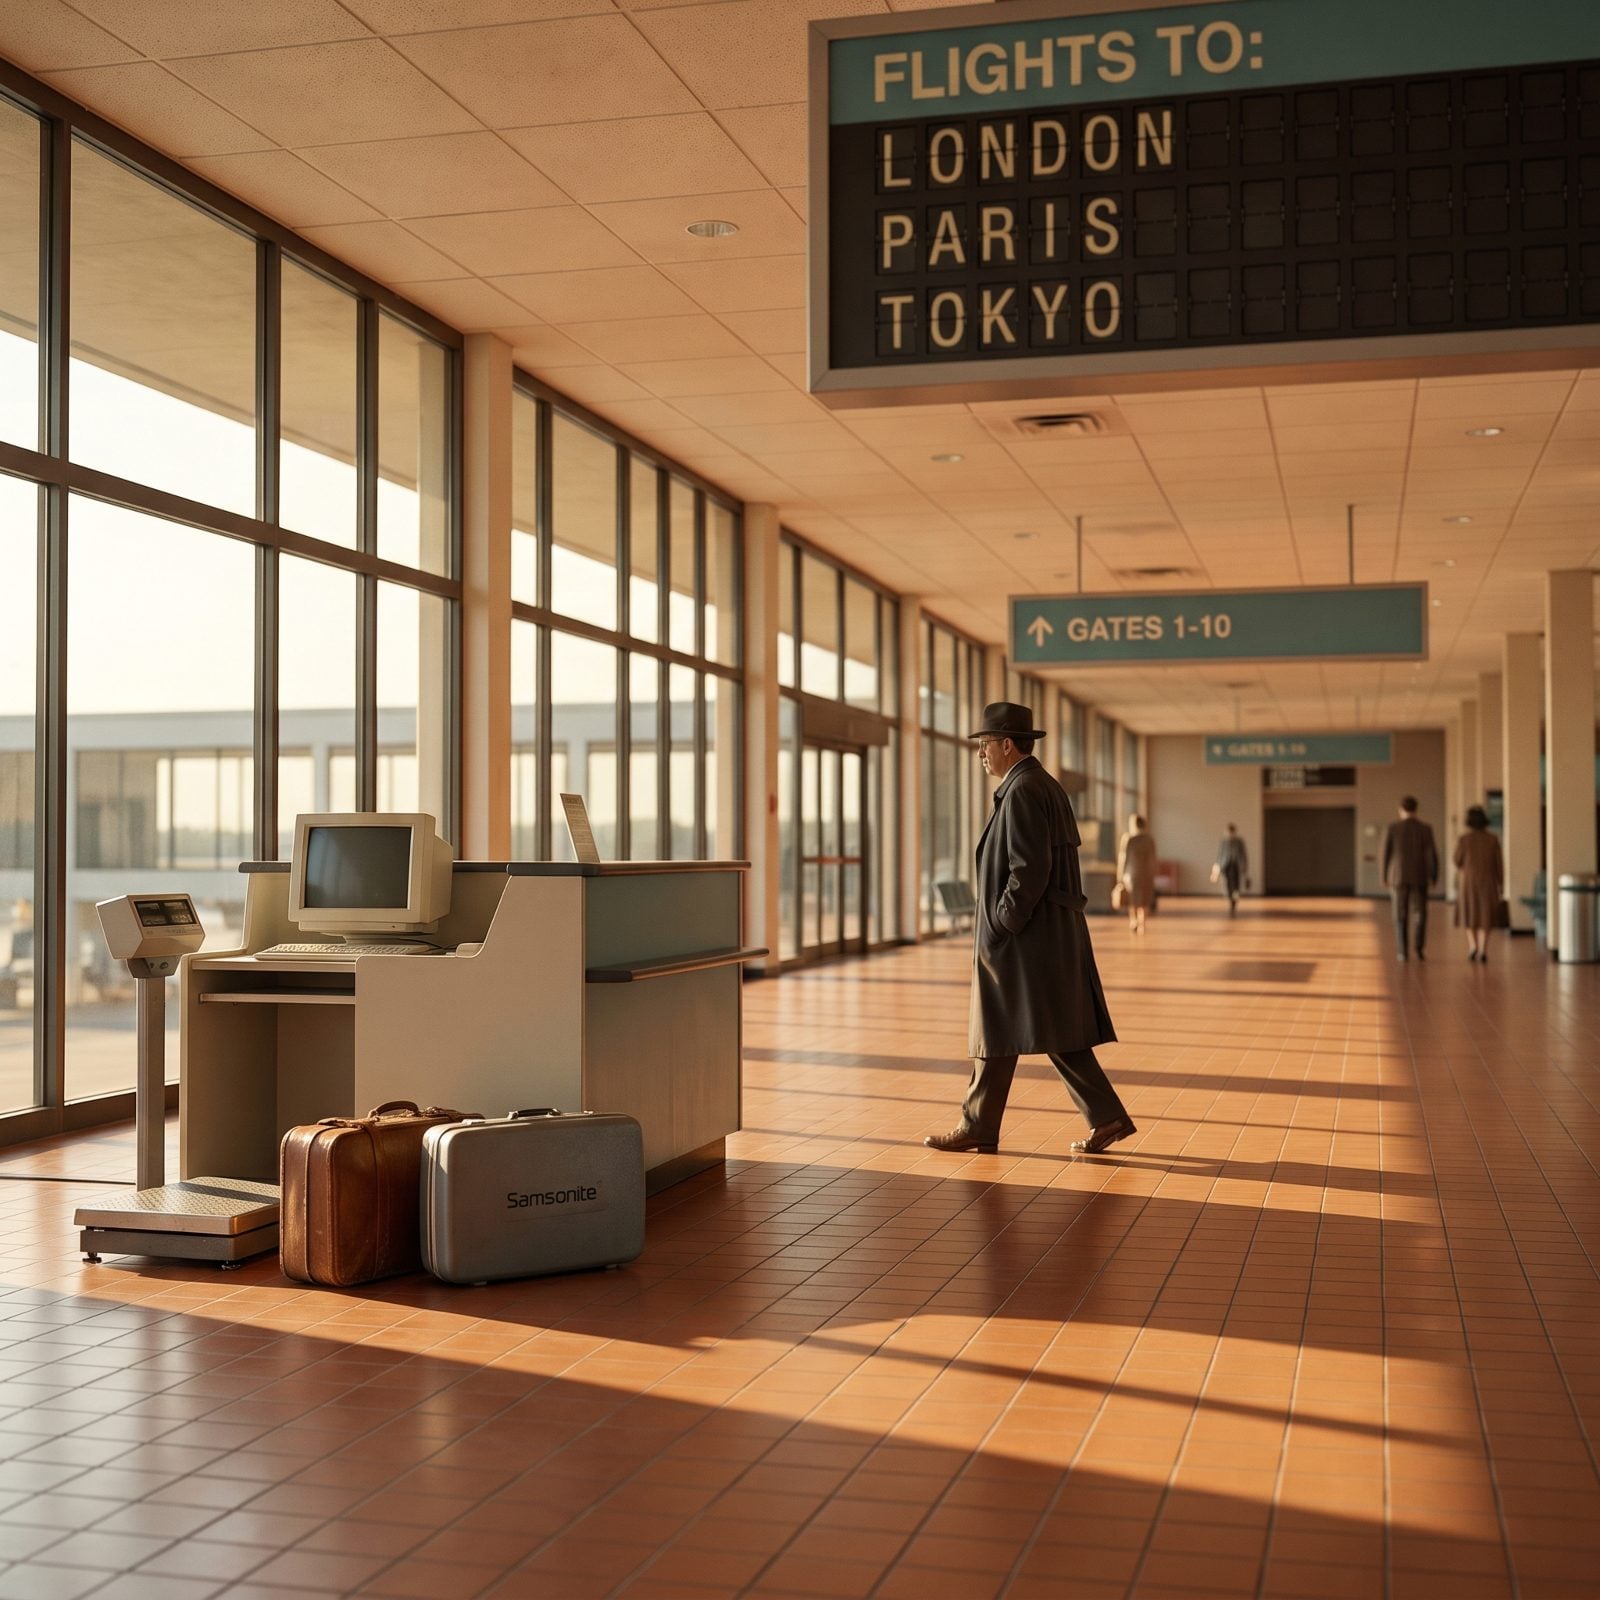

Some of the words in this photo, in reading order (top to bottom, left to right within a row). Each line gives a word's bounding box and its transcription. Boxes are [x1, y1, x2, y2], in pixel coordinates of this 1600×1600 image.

[874, 31, 1136, 102] FLIGHTS
[1156, 21, 1264, 76] TO:
[883, 111, 1173, 187] LONDON
[882, 198, 1120, 269] PARIS
[881, 281, 1121, 349] TOKYO
[1067, 615, 1163, 642] GATES
[1174, 614, 1232, 639] 1-10
[507, 1186, 597, 1208] Samsonite
